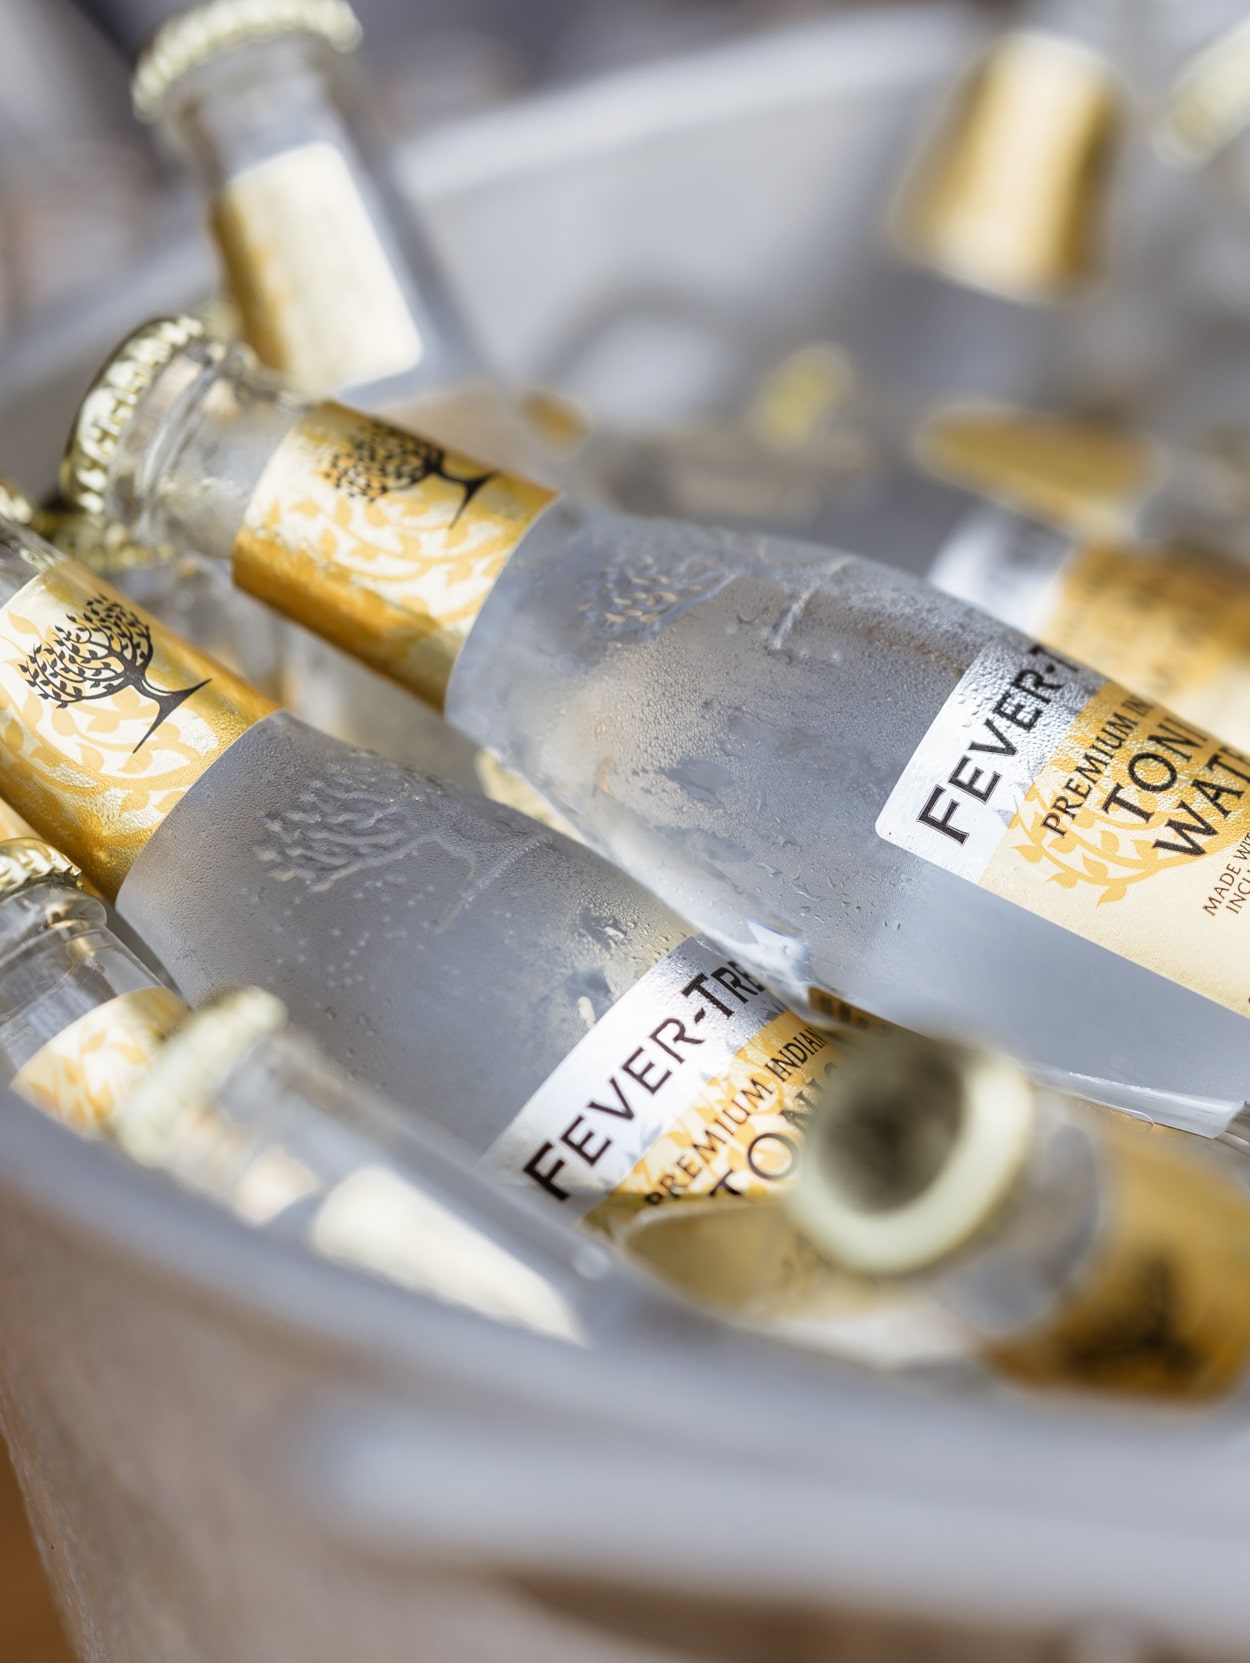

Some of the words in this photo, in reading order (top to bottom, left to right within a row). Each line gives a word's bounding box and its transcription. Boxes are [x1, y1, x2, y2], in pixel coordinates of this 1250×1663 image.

[1041, 711, 1139, 838] PREMIUM
[1102, 716, 1209, 824] TONI
[1202, 863, 1242, 917] MADE
[645, 1077, 775, 1207] PREMIUM
